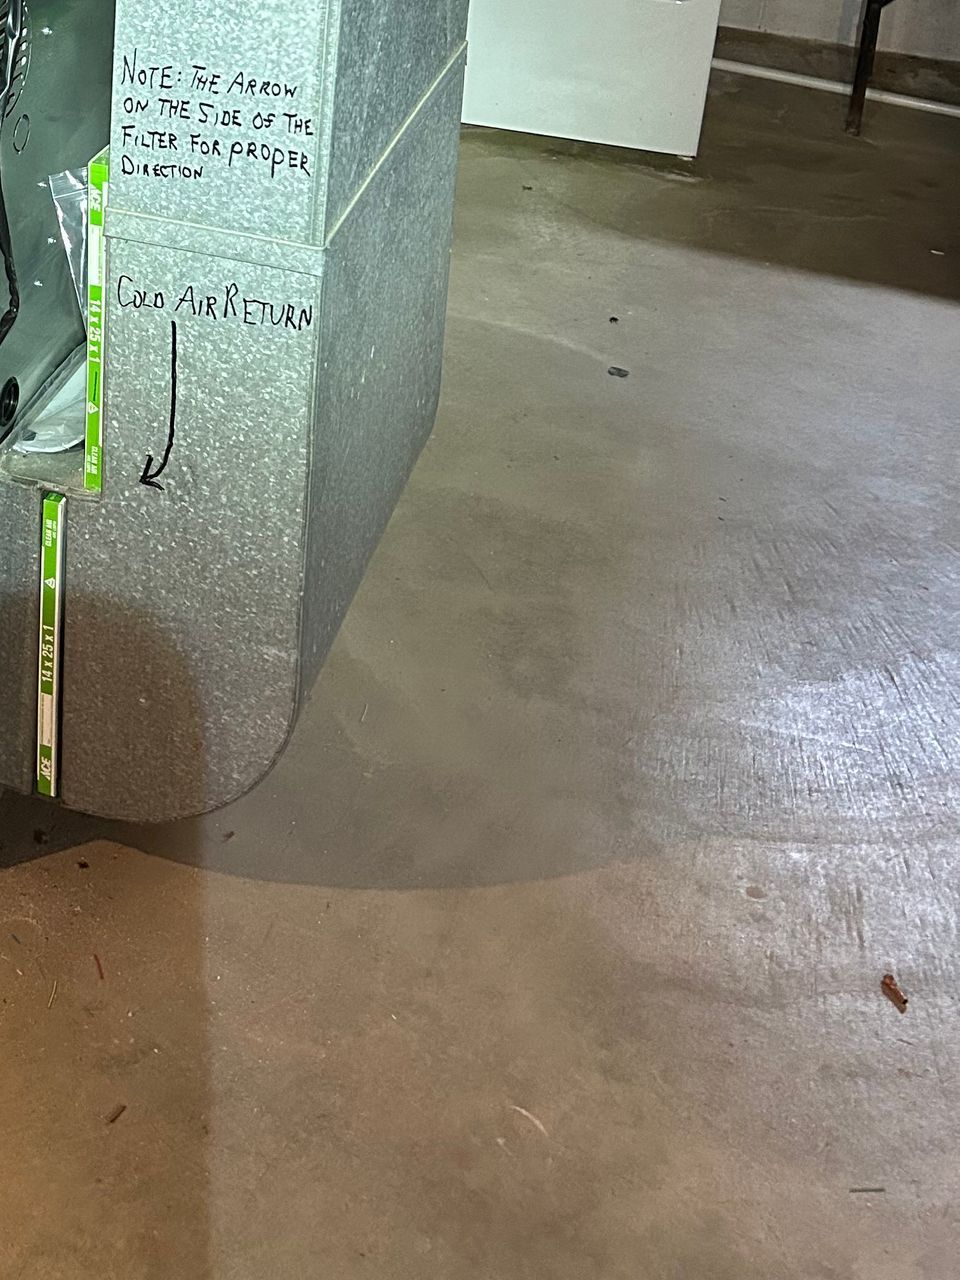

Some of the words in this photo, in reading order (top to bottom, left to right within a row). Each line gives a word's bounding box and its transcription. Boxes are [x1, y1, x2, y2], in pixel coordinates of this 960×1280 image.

[121, 48, 183, 90] NOTE:
[190, 65, 221, 94] THE
[227, 71, 298, 98] ARROW
[124, 96, 149, 113] ON
[158, 98, 190, 120] THE
[198, 102, 242, 127] SIDE
[283, 112, 314, 136] THE
[121, 125, 178, 150] FILTER
[190, 133, 221, 157] FOR
[229, 140, 311, 178] PROPER
[121, 155, 204, 180] DIRECTION
[90, 183, 102, 212] ACE
[90, 299, 101, 312] 14
[117, 275, 165, 309] COLD
[175, 285, 217, 320] AIR
[223, 282, 313, 331] RETURN
[90, 327, 101, 343] 25
[42, 644, 53, 659] 25
[41, 670, 52, 682] 14
[40, 756, 51, 780] ACE
